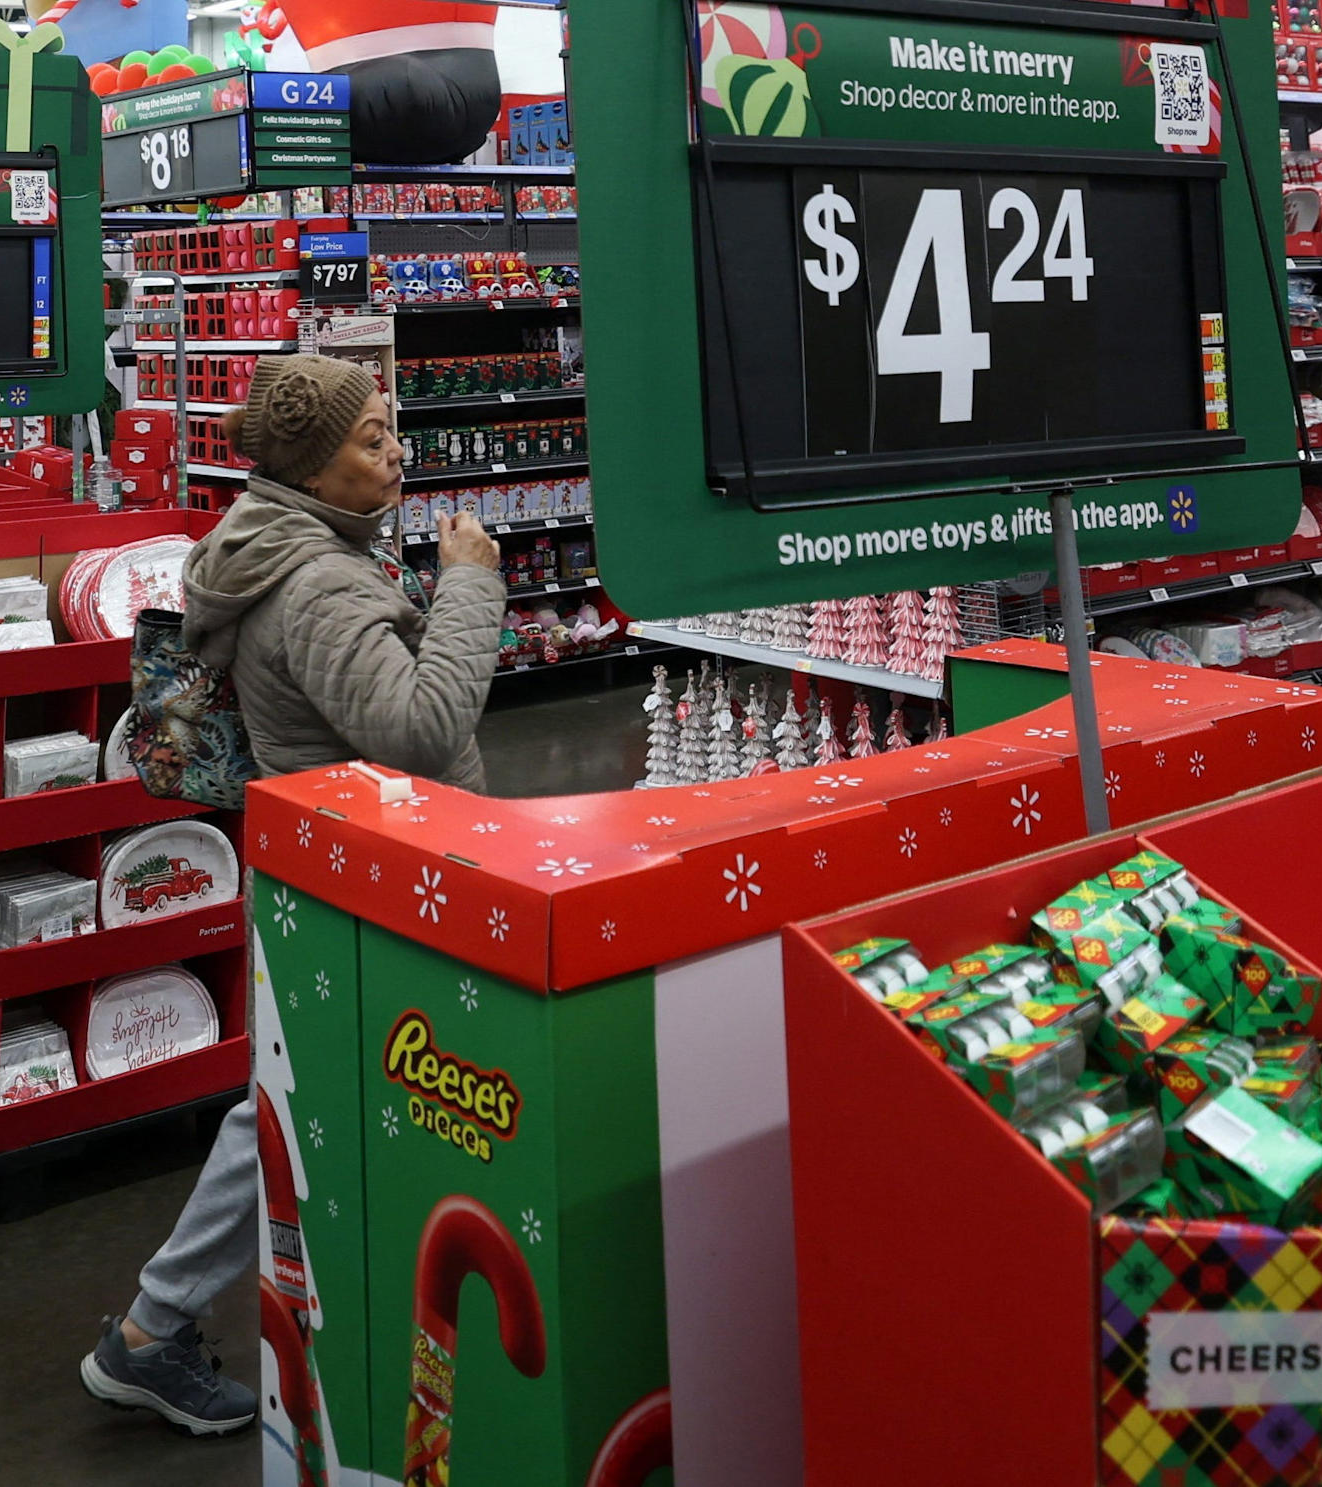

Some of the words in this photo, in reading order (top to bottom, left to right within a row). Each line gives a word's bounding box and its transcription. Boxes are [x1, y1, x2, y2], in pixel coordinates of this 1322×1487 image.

[890, 37, 965, 74] Make
[969, 40, 990, 75] it
[993, 49, 1074, 85] merry
[282, 81, 299, 104] G
[306, 81, 334, 104] 24
[135, 99, 150, 112] Bring
[150, 98, 158, 109] the
[159, 93, 182, 108] holidays
[182, 90, 201, 103] home
[840, 80, 896, 110] Shop
[899, 85, 958, 111] decor
[960, 88, 975, 111] &
[978, 94, 1027, 114] more
[1030, 93, 1045, 114] in
[1048, 94, 1080, 117] the
[1083, 99, 1120, 122] app.
[262, 116, 277, 125] Feliz
[278, 115, 300, 125] Navidad
[301, 116, 318, 126] Bags
[319, 116, 325, 124] &
[325, 117, 342, 127] Wrap
[1167, 126, 1183, 137] Shop
[1184, 128, 1197, 136] now
[276, 135, 304, 144] Cosmetic
[305, 135, 318, 144] Gift
[318, 135, 331, 144] Sets
[272, 154, 302, 163] Christmas
[303, 154, 336, 163] Partyware
[311, 243, 324, 251] Low
[37, 276, 46, 285] FT
[36, 300, 44, 309] 12
[778, 529, 851, 566] Shop
[856, 524, 927, 558] more
[931, 515, 987, 552] toys
[990, 513, 1008, 542] &
[1012, 503, 1052, 544] ifts
[1082, 501, 1117, 530] the
[1122, 500, 1164, 530] app.
[199, 922, 235, 936] Partyware
[1245, 969, 1266, 982] 100
[112, 1005, 180, 1045] Holidays
[389, 1019, 516, 1130] Reese's
[1169, 1074, 1198, 1090] 100
[1170, 1339, 1321, 1374] CHEERS
